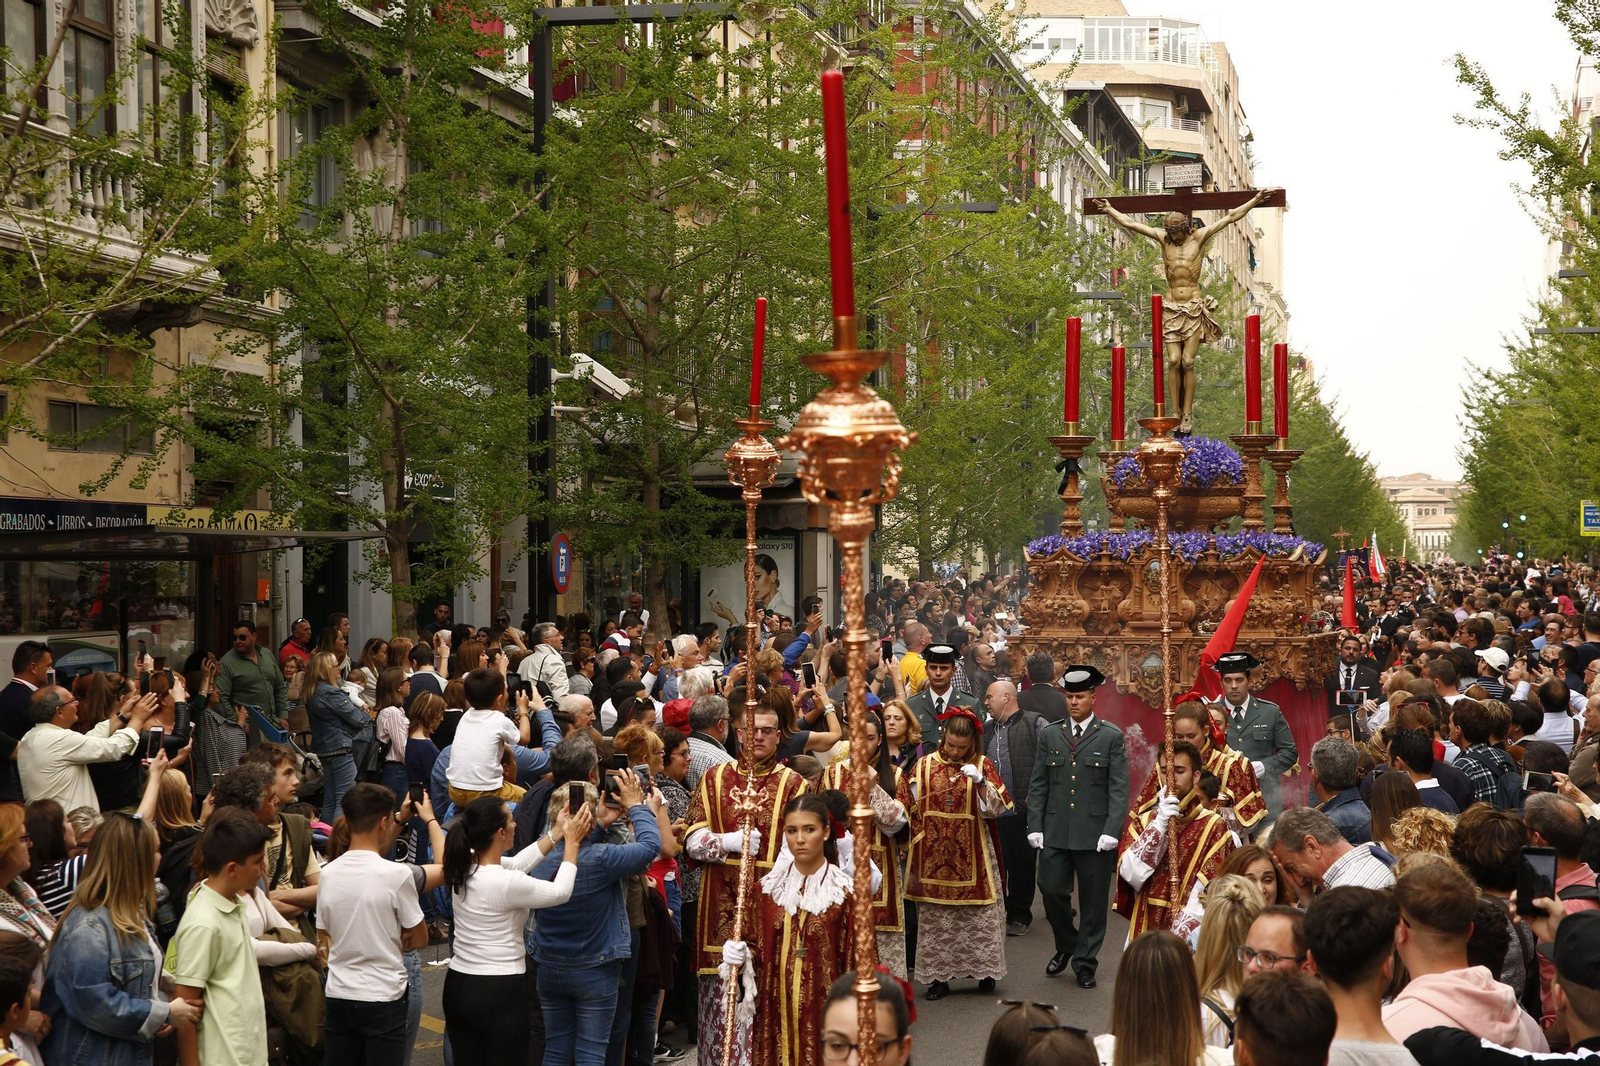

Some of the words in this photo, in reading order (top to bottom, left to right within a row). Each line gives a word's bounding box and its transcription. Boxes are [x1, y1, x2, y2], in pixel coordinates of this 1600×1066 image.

[414, 473, 444, 489] exprs
[0, 512, 46, 531] GRABADOS
[56, 514, 86, 530] LIBROS
[758, 543, 780, 551] alaxy
